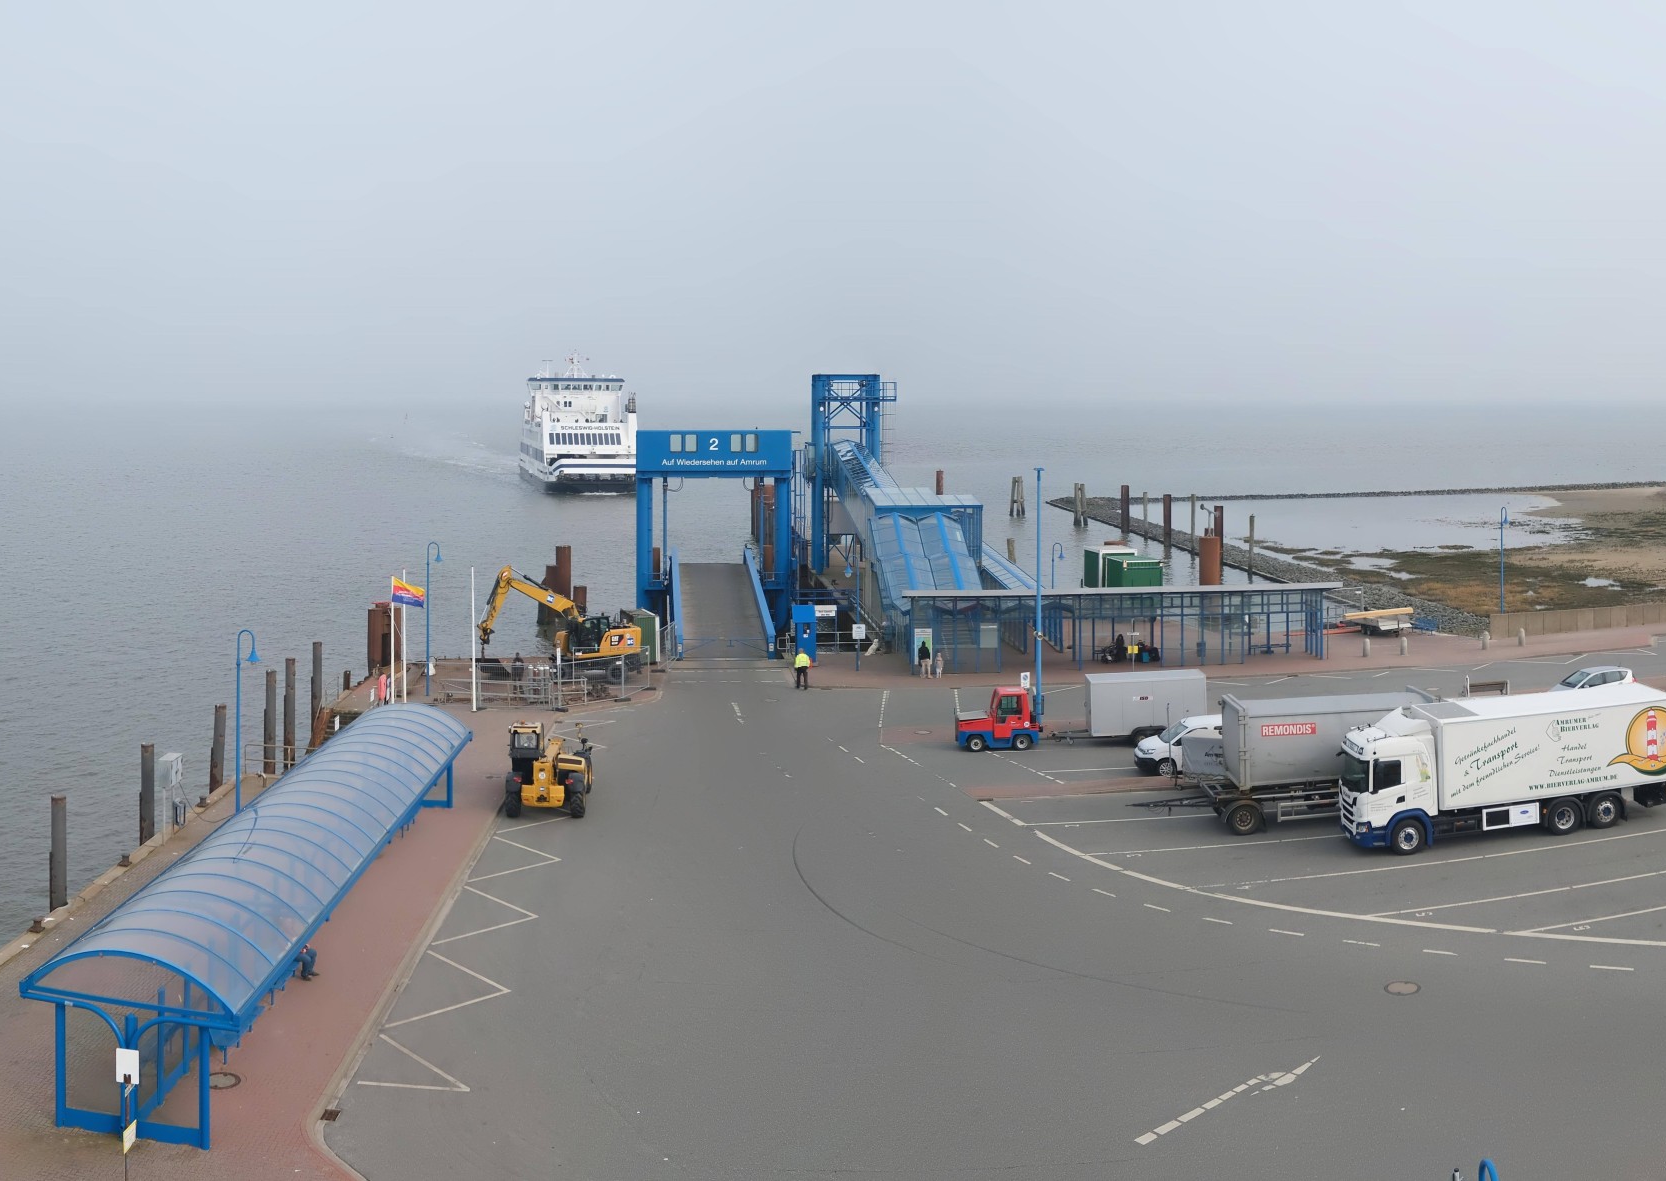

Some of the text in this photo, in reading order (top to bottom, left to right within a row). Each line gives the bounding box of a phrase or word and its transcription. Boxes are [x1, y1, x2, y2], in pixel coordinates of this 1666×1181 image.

[709, 438, 719, 451] 2
[1555, 717, 1587, 726] AMRUMER
[1560, 723, 1599, 732] BIERVERLAG
[1561, 743, 1587, 752] Handel
[1470, 741, 1518, 770] Transport
[1556, 755, 1593, 765] Transport
[1451, 789, 1461, 798] mit
[1462, 782, 1475, 792] dem
[1514, 744, 1540, 764] Service!
[1548, 766, 1602, 777] Dienstleistungen
[1528, 774, 1618, 791] WWW.BIERVERLAG-AMRUM.DE
